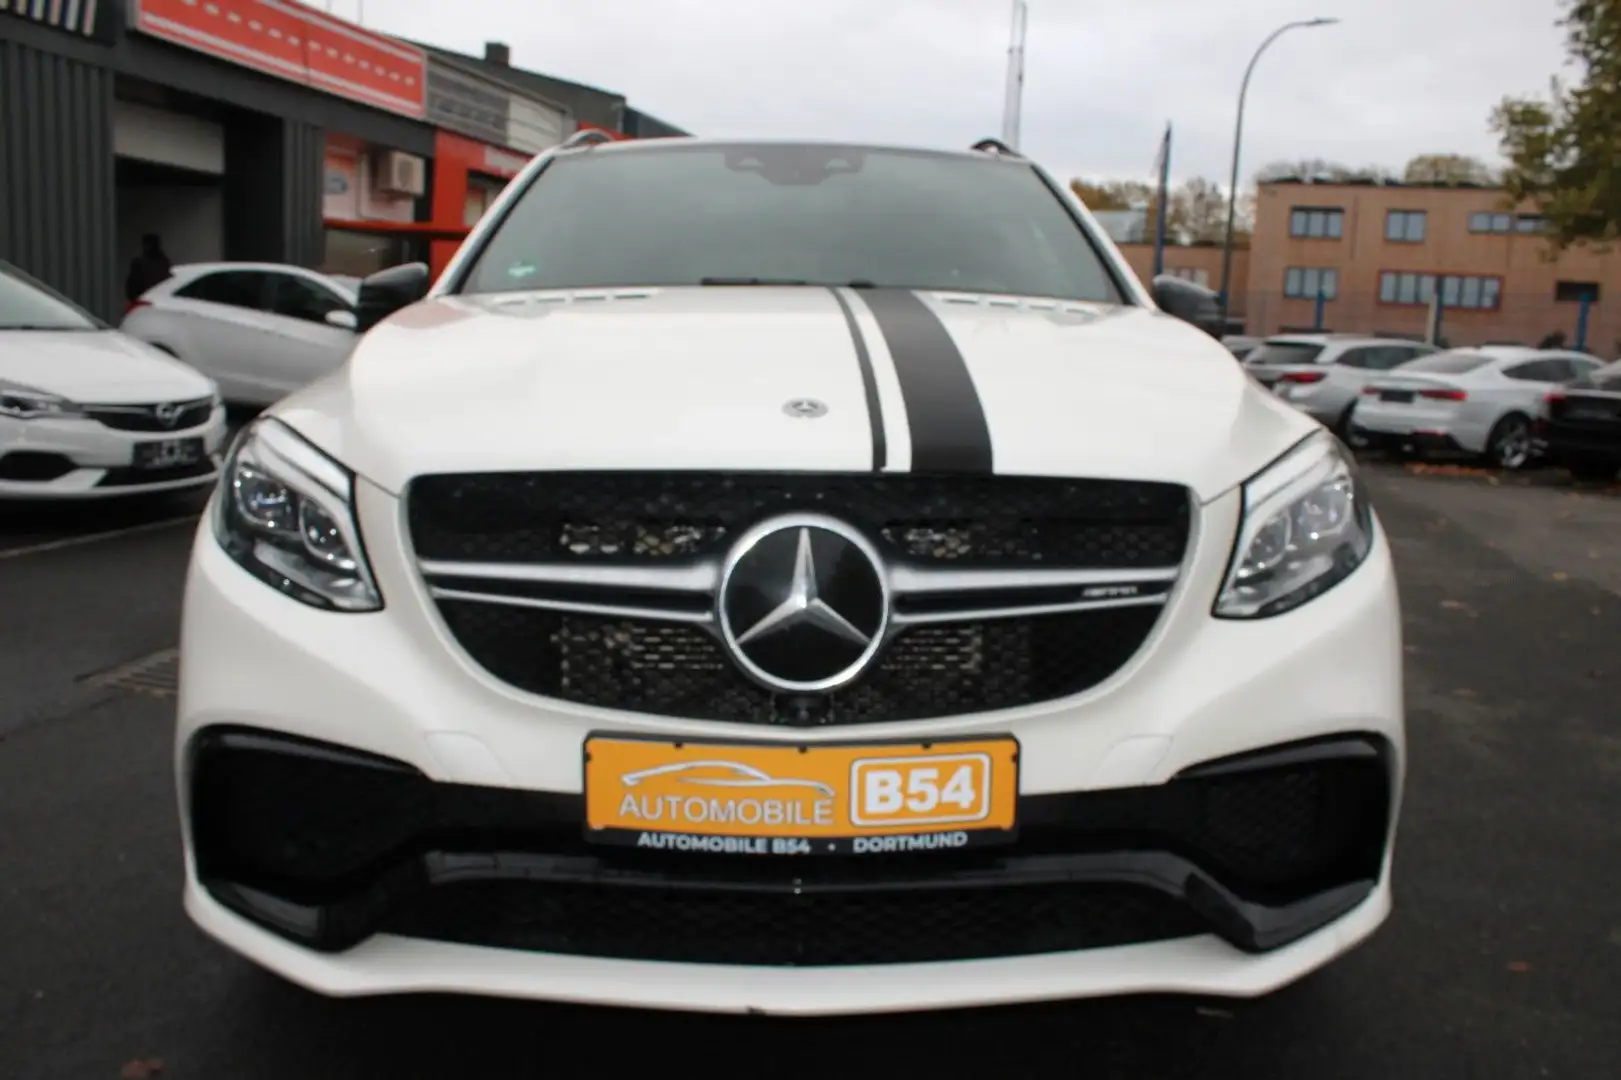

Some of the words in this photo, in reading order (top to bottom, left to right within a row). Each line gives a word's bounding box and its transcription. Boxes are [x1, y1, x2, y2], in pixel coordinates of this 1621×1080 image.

[619, 793, 835, 825] AUTOMOBILE
[864, 765, 976, 813] B54
[637, 831, 767, 854] AUTOMOBILE
[772, 836, 811, 855] B54
[852, 831, 968, 853] DORTMUND
